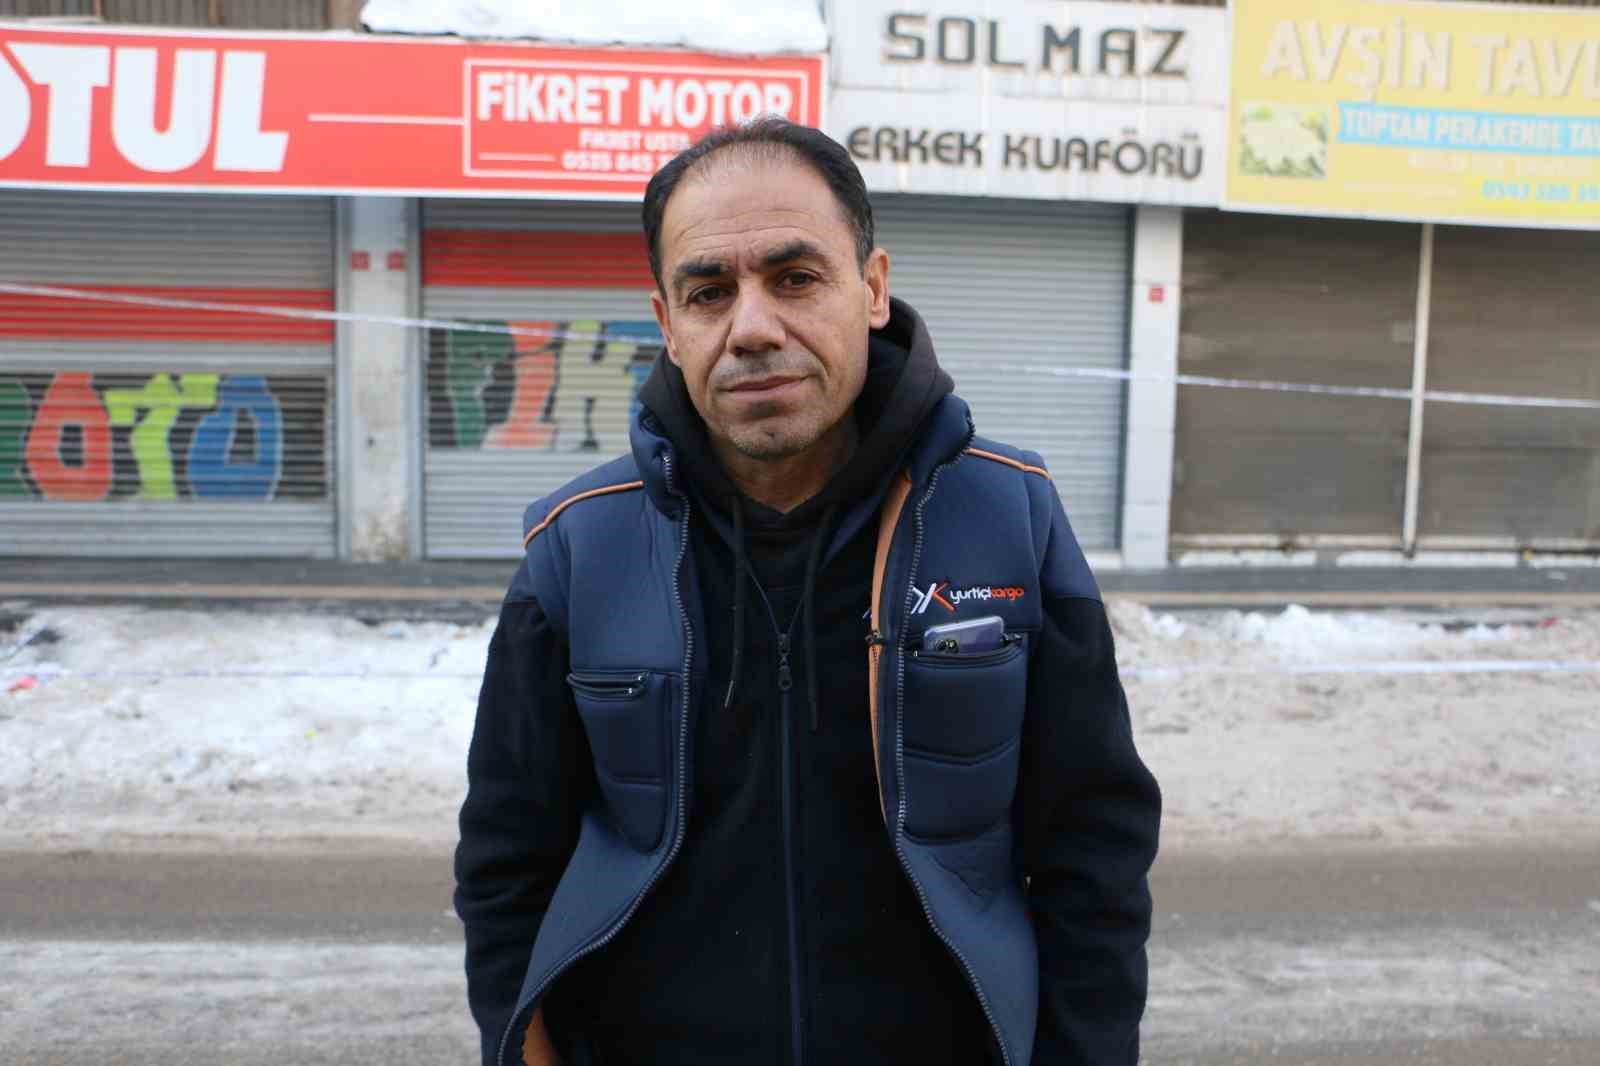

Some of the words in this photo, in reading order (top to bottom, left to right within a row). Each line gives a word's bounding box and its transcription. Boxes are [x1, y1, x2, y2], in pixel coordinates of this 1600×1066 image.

[880, 12, 1188, 77] SOLMAZ
[638, 78, 793, 129] MOTOR
[847, 126, 984, 170] ERKEK
[1003, 129, 1204, 181] KUAFÖRÜ
